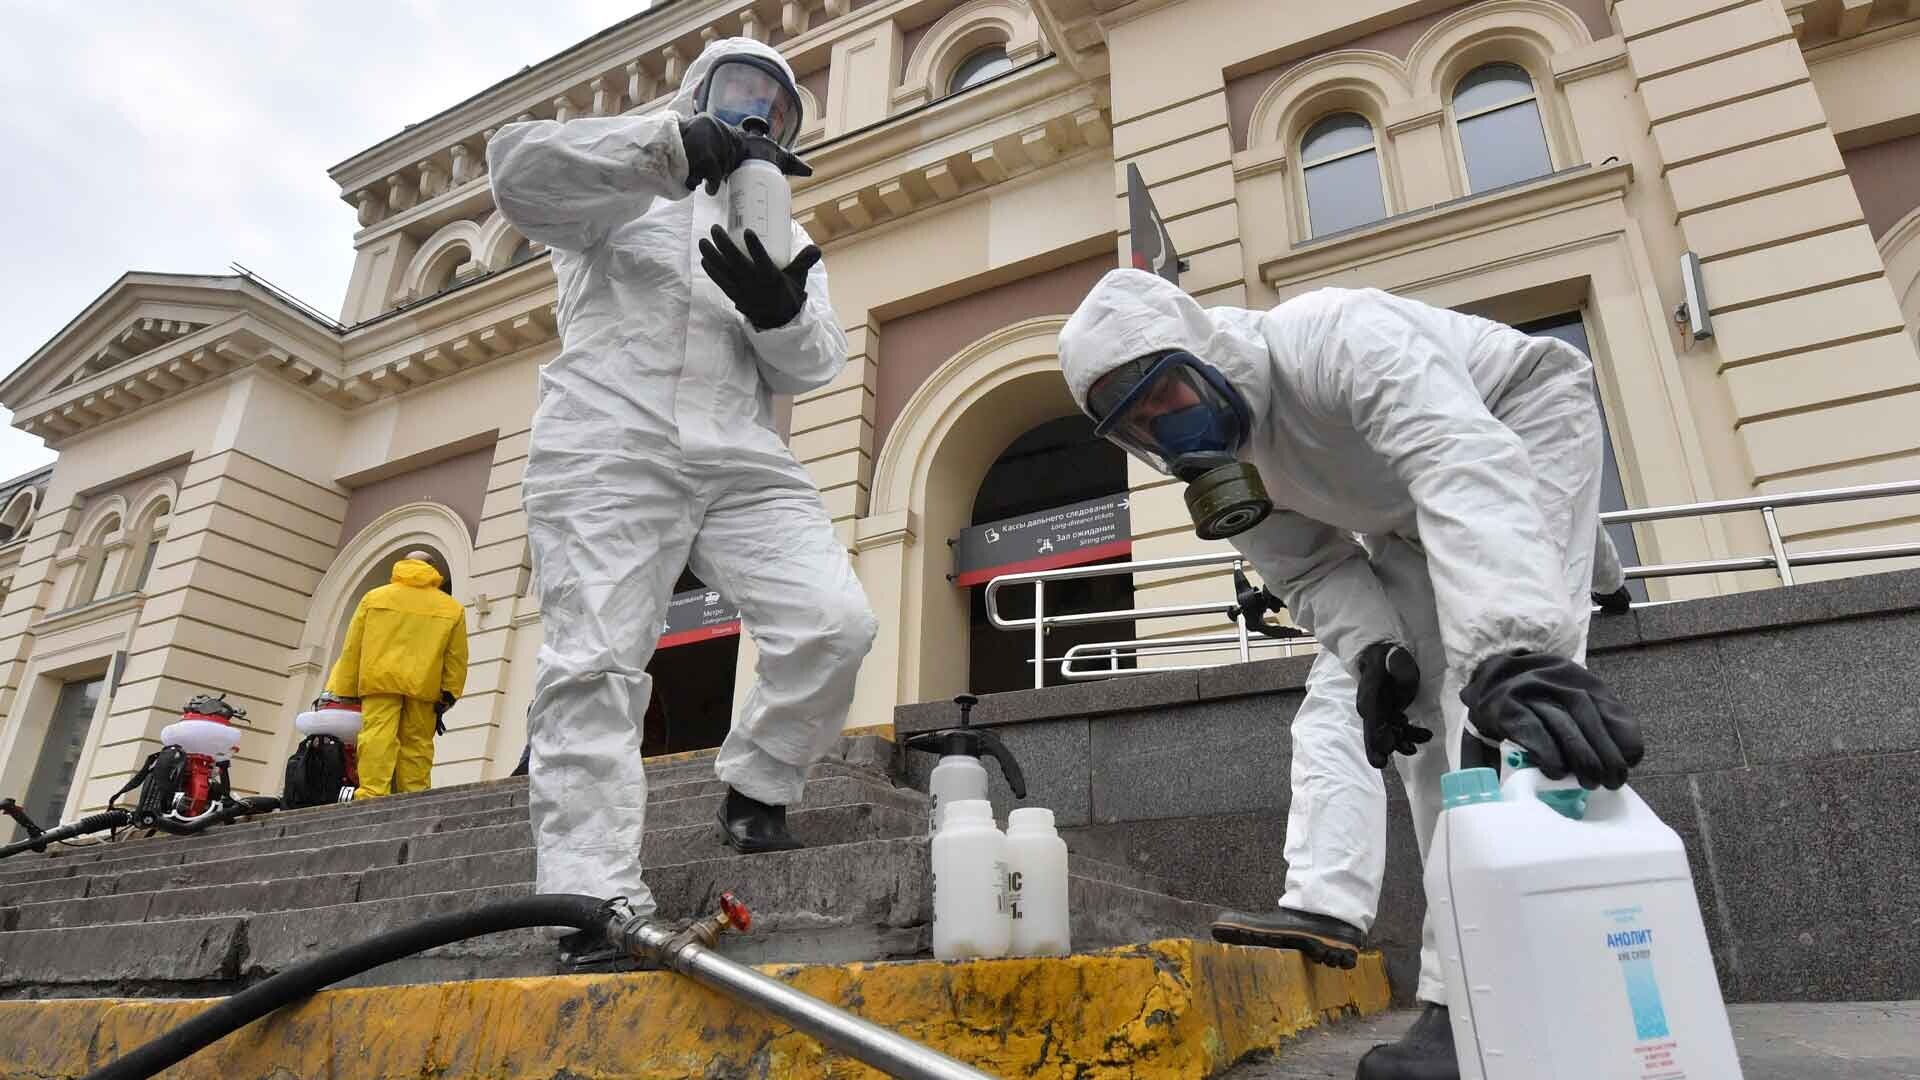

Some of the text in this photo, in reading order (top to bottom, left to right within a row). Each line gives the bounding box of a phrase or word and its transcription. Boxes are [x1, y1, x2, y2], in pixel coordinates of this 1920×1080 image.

[1002, 503, 1114, 532] Кассы дальнего следования
[1056, 524, 1115, 542] Зал ожидания
[1607, 929, 1653, 948] АНОЛИТ
